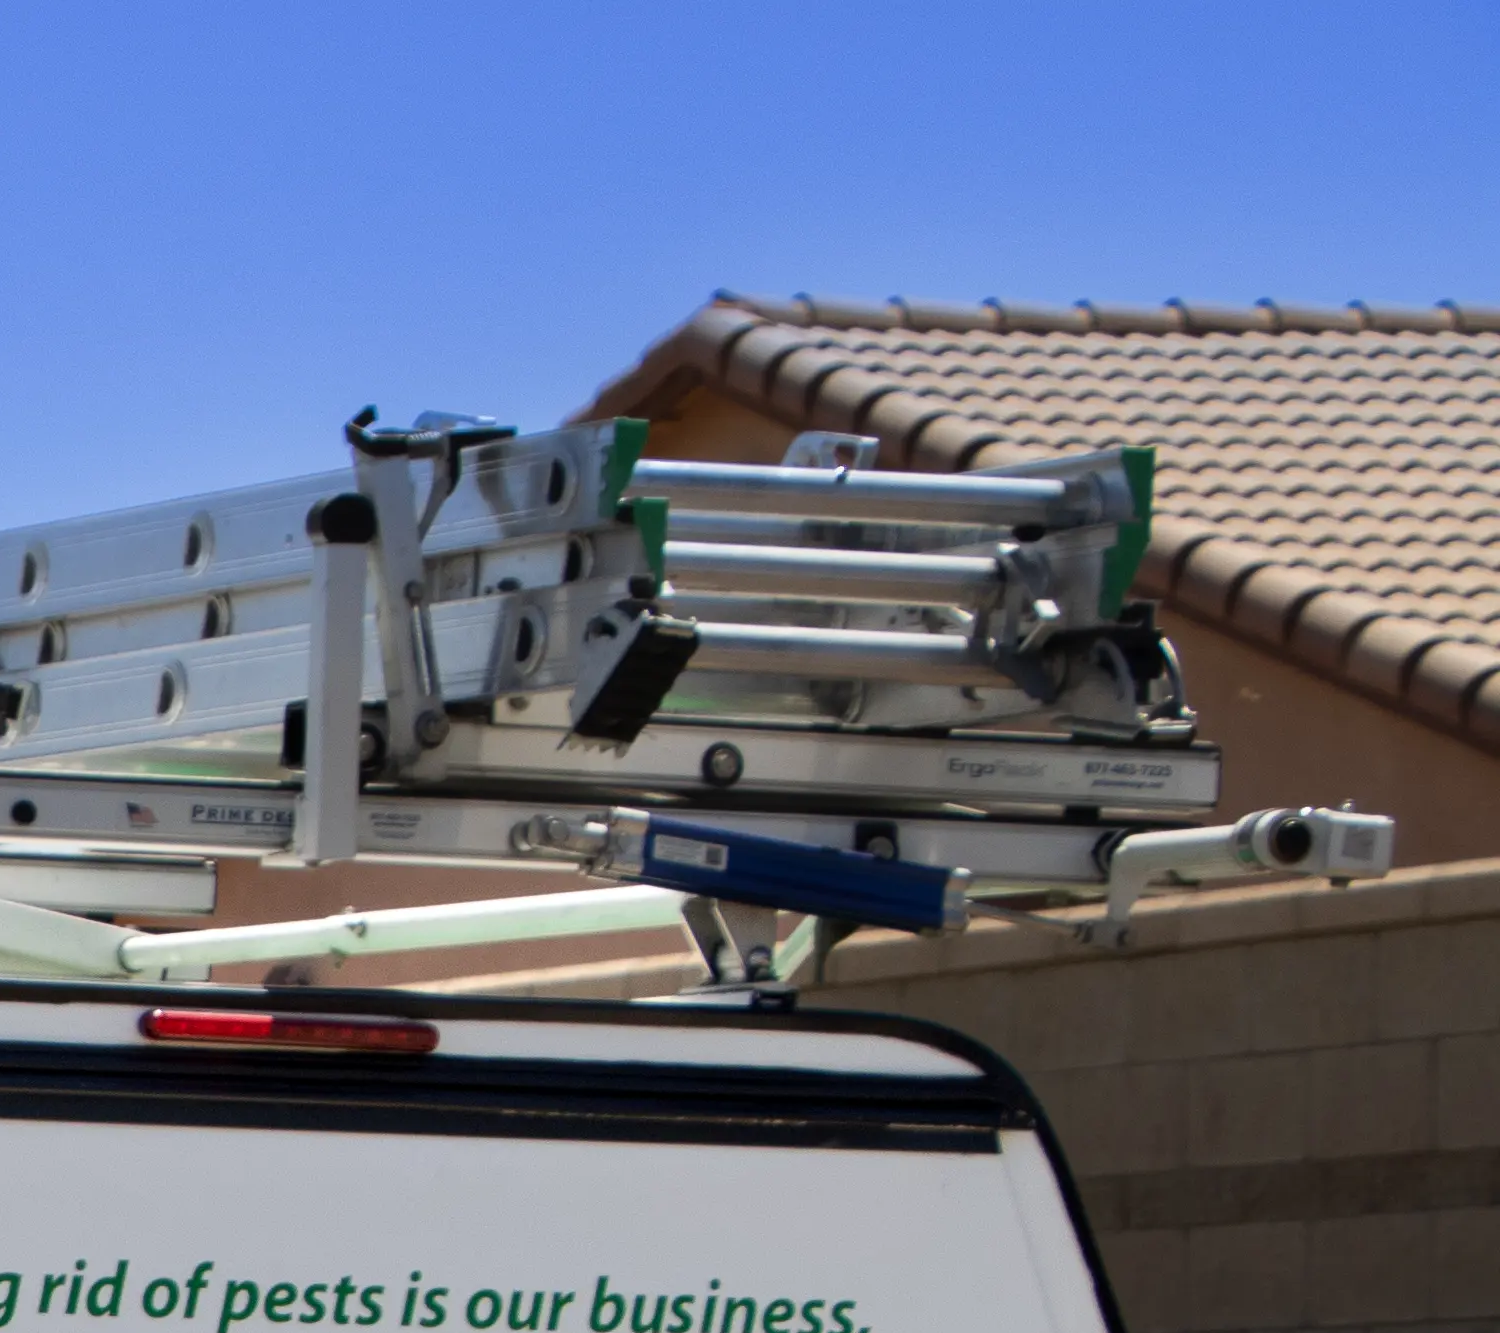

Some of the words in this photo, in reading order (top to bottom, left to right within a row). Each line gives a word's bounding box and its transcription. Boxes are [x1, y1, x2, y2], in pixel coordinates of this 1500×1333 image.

[39, 1260, 129, 1317] rid
[143, 1261, 214, 1319] of
[401, 1271, 449, 1328] is
[466, 1289, 575, 1332] our
